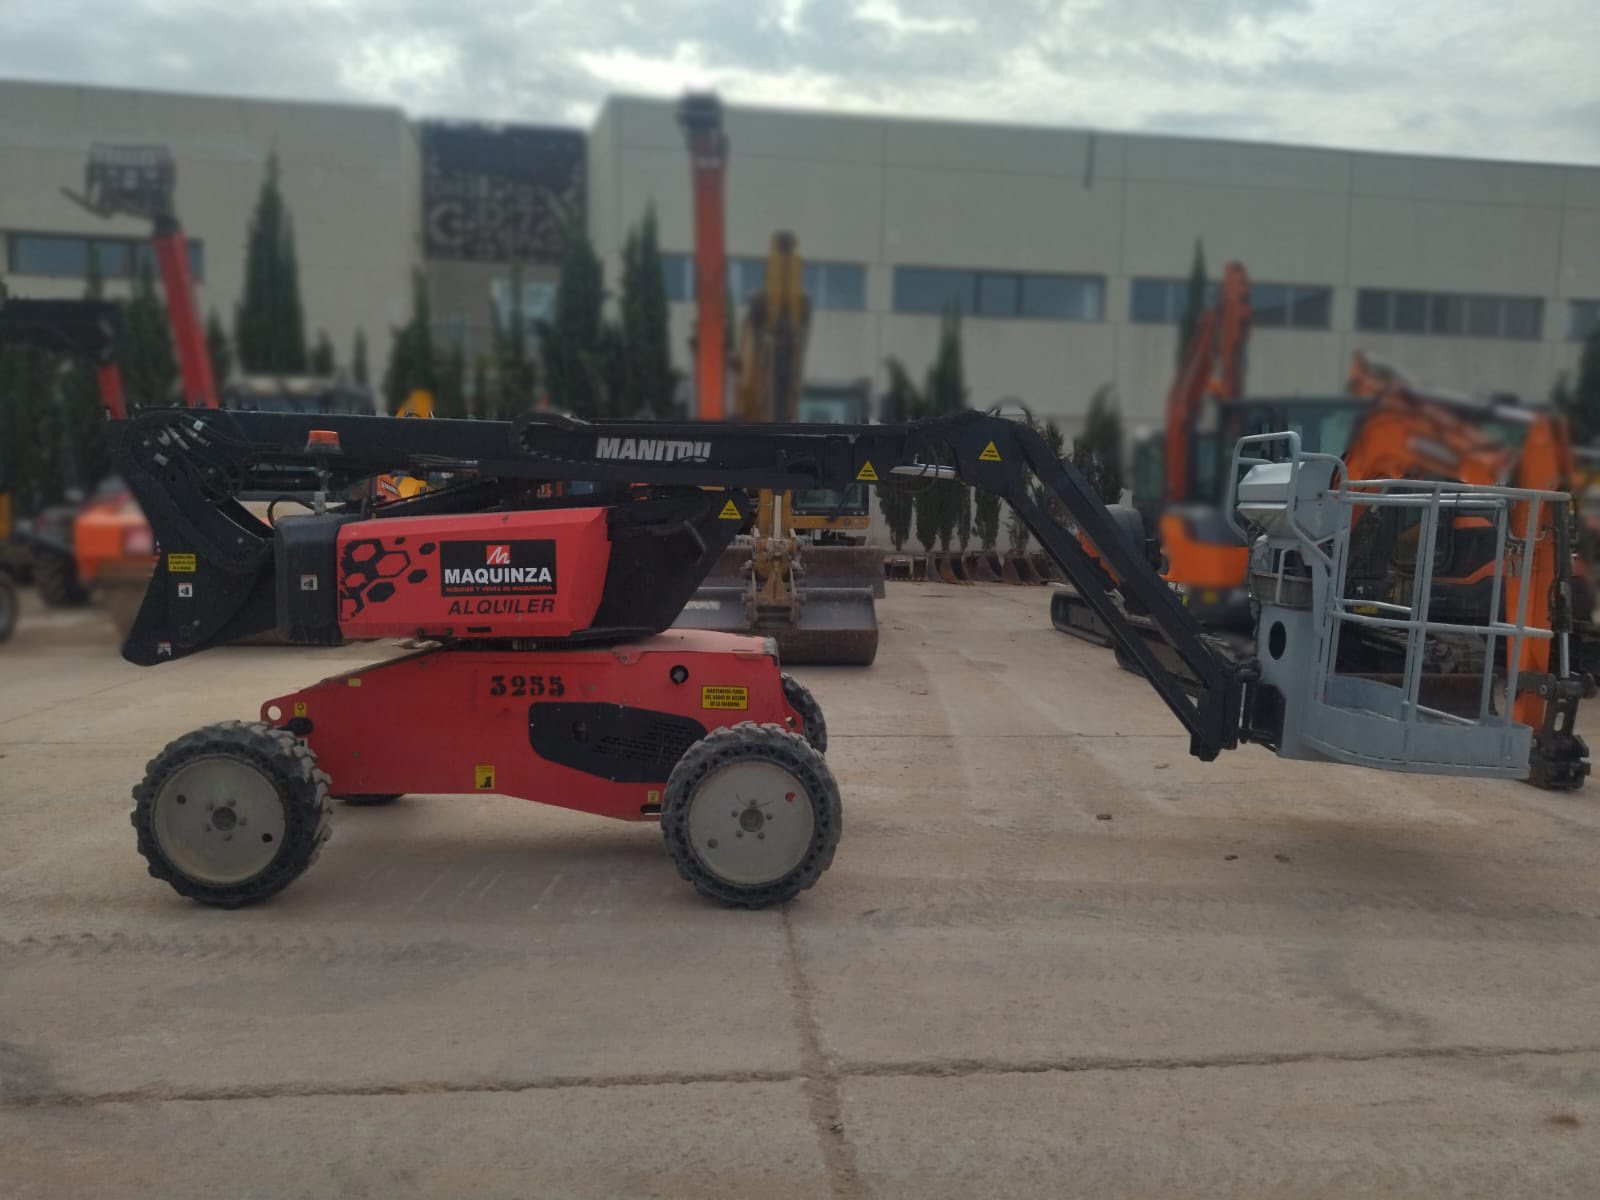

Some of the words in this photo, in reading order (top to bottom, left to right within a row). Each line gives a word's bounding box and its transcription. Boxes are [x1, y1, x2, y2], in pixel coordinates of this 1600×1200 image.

[596, 437, 712, 462] MANITOU
[444, 568, 552, 584] MAQUINZA
[448, 598, 556, 615] ALQUILER
[490, 675, 565, 697] 3255
